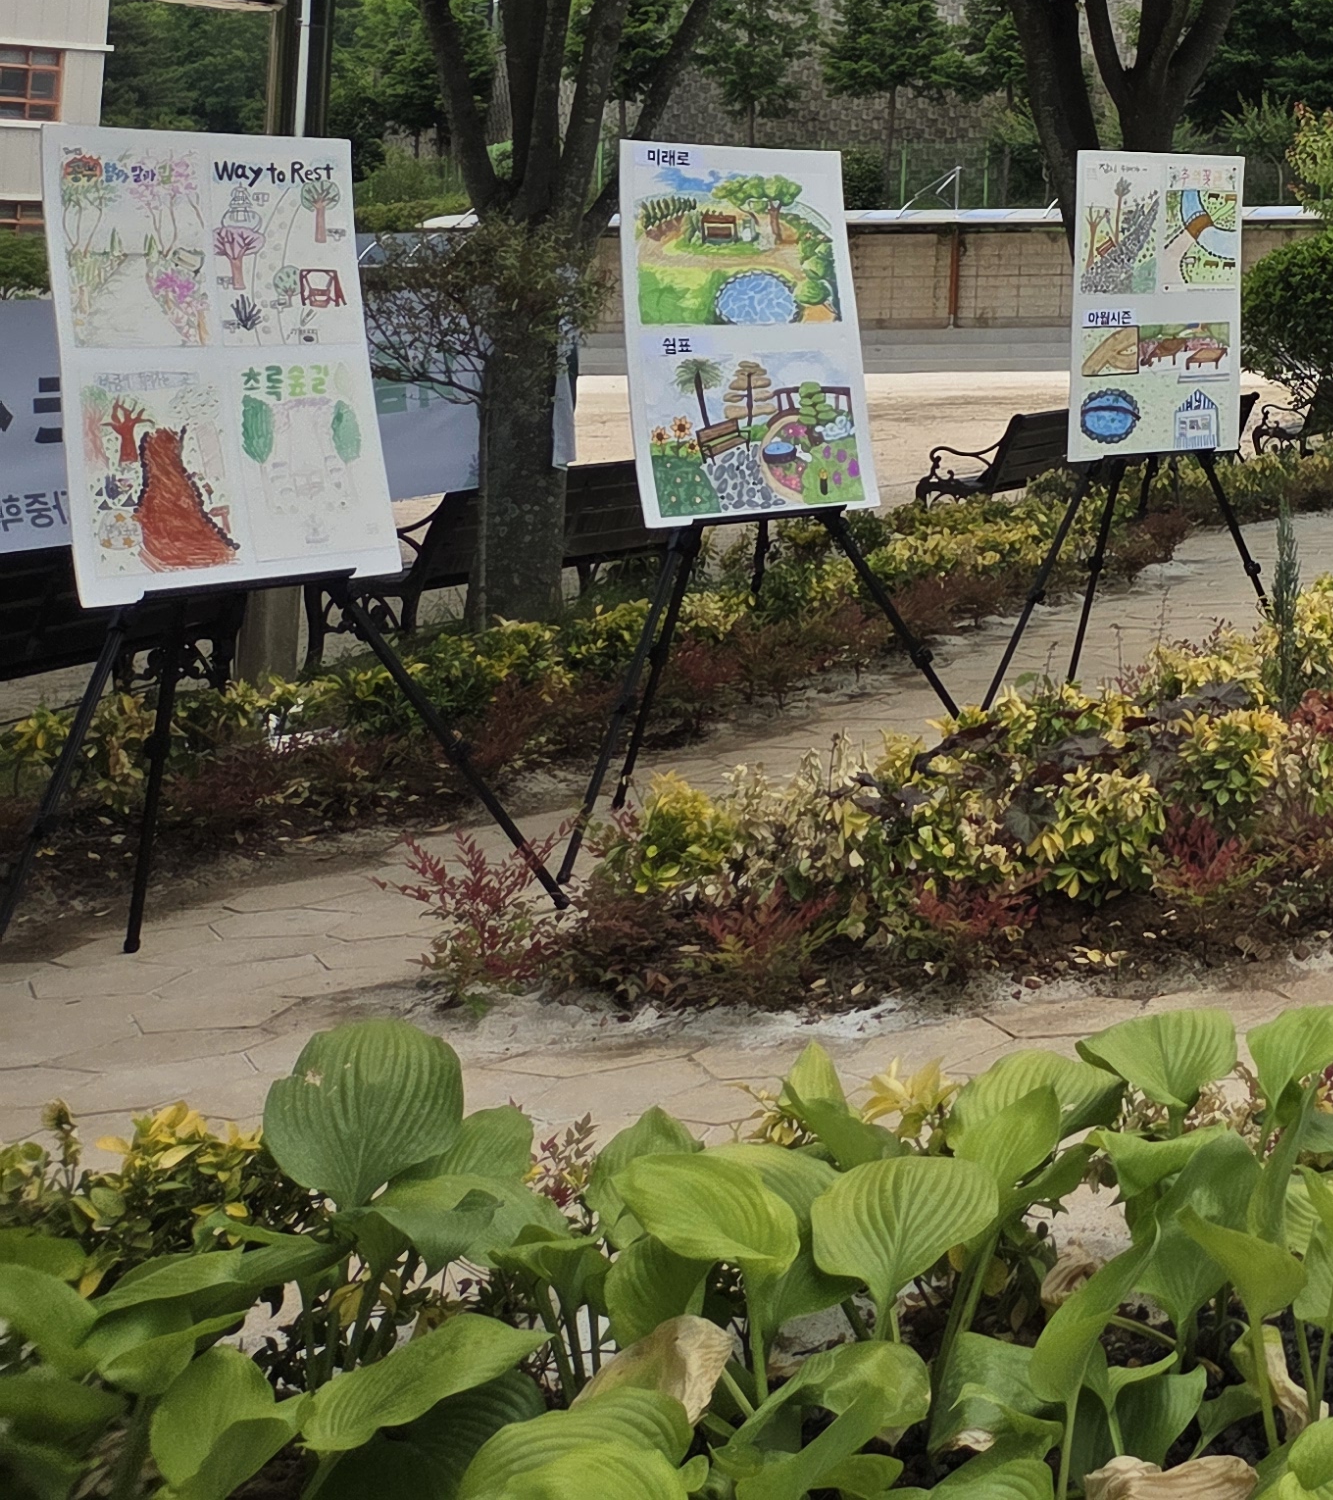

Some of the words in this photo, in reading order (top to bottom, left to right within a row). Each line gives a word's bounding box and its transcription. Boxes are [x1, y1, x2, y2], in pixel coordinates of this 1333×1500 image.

[647, 149, 691, 167] 미래로
[214, 160, 263, 188] Way
[266, 162, 286, 184] to
[291, 161, 334, 184] Rest
[662, 337, 692, 355] 쉼표
